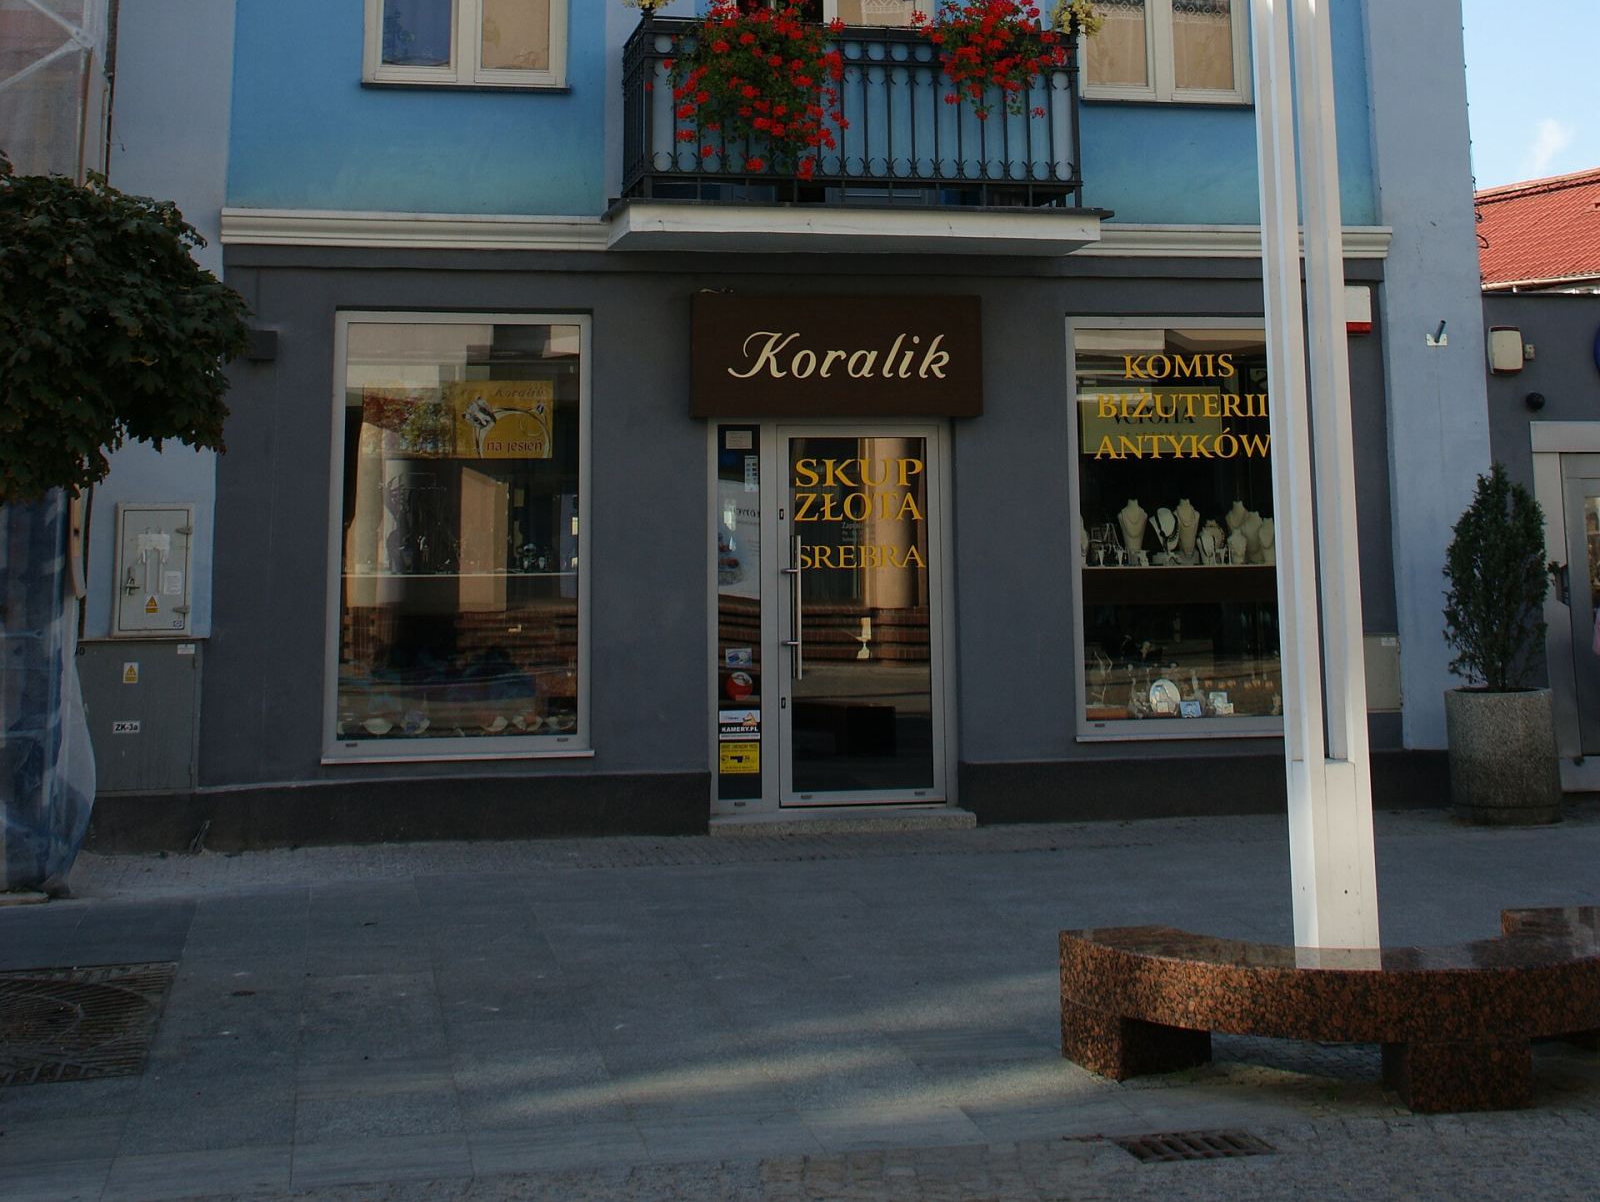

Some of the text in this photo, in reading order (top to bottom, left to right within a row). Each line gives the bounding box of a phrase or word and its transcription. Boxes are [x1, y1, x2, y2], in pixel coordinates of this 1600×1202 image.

[728, 331, 950, 379] Koralik
[1123, 353, 1236, 379] KOMIS
[1097, 387, 1269, 418] BIŻUTERII
[487, 441, 502, 451] na
[1094, 427, 1271, 460] ANTYKÓW
[795, 458, 924, 487] SKUP
[794, 492, 923, 522] ZŁOTA
[800, 545, 926, 569] SREBRA
[115, 723, 138, 732] ZK-3a
